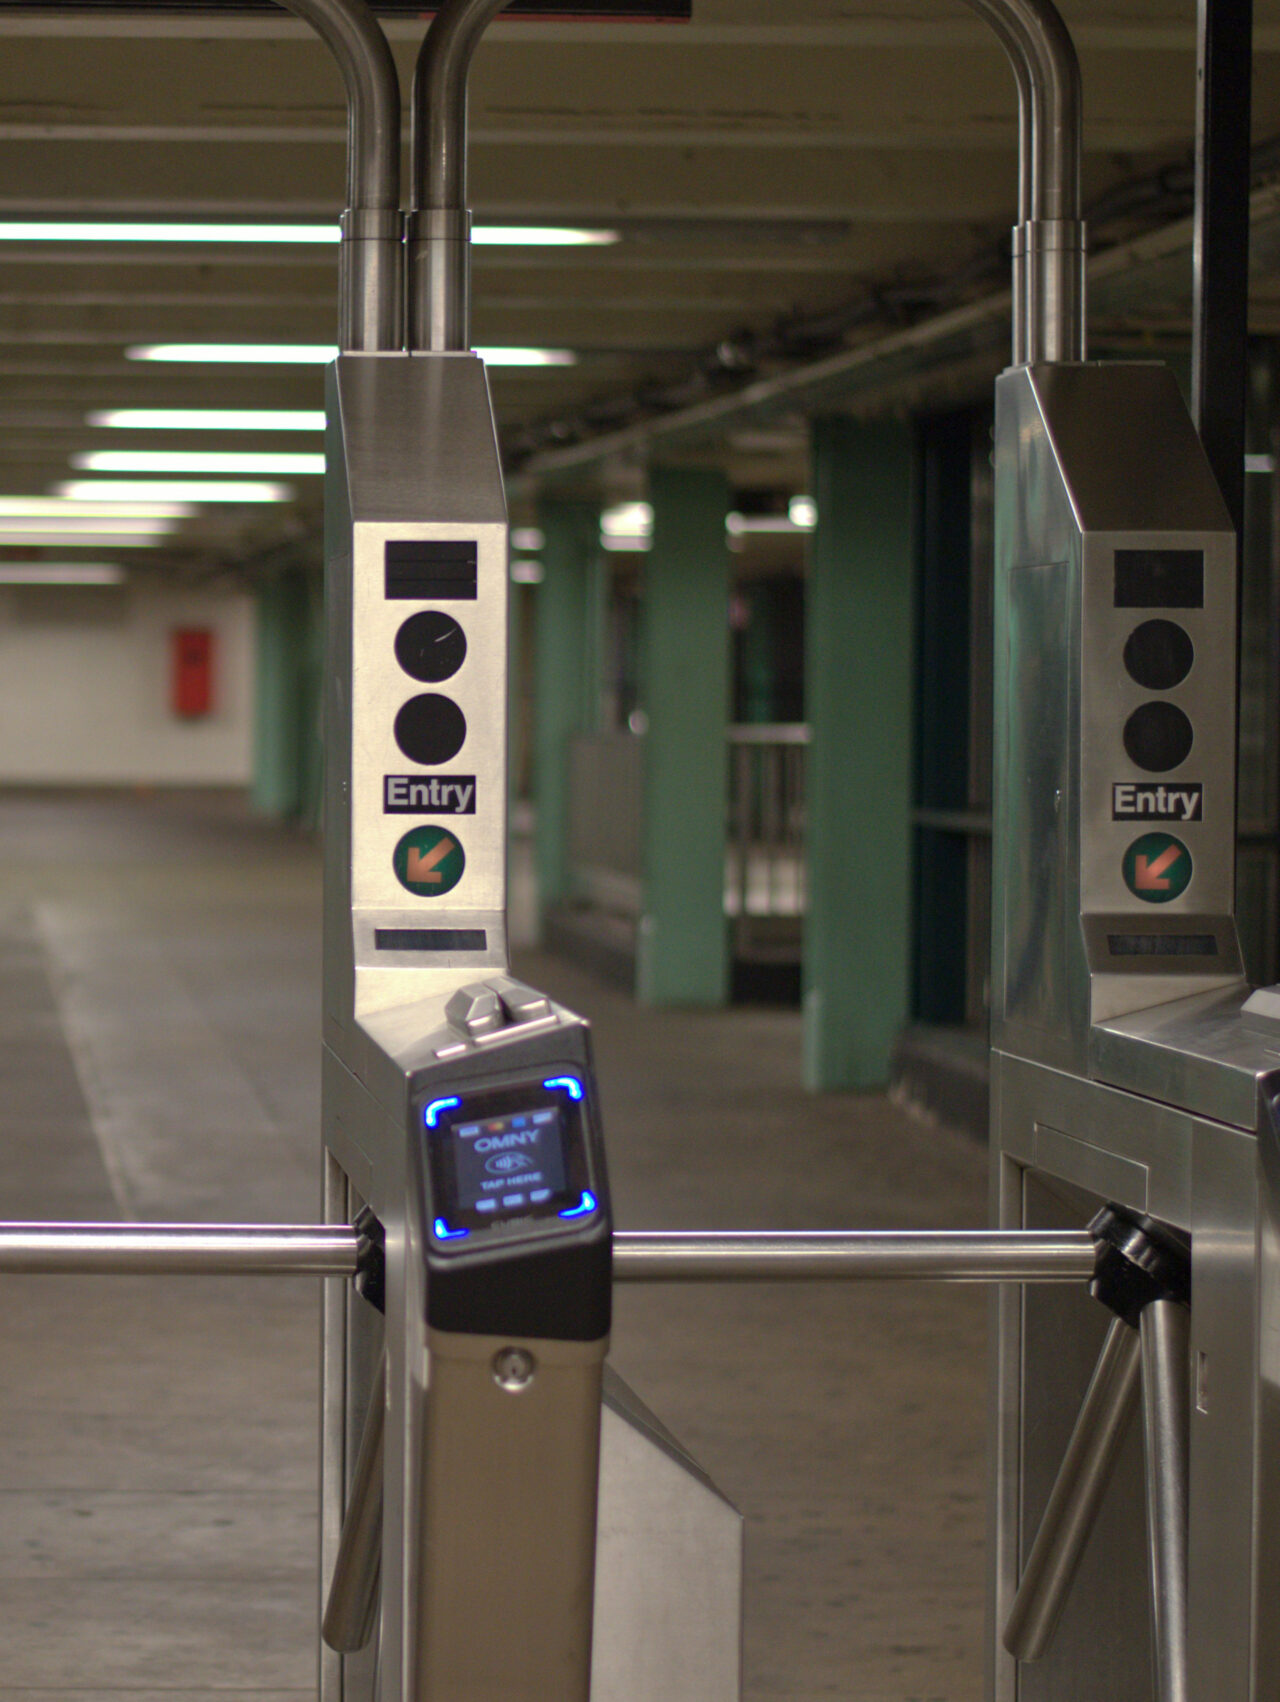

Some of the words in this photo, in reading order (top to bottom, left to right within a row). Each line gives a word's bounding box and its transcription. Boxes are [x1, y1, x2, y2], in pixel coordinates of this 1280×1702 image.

[387, 777, 473, 813] Entry
[1115, 785, 1199, 820] Entry
[474, 1129, 540, 1152] OMNY
[480, 1178, 504, 1191] TAP
[507, 1171, 542, 1185] HERE
